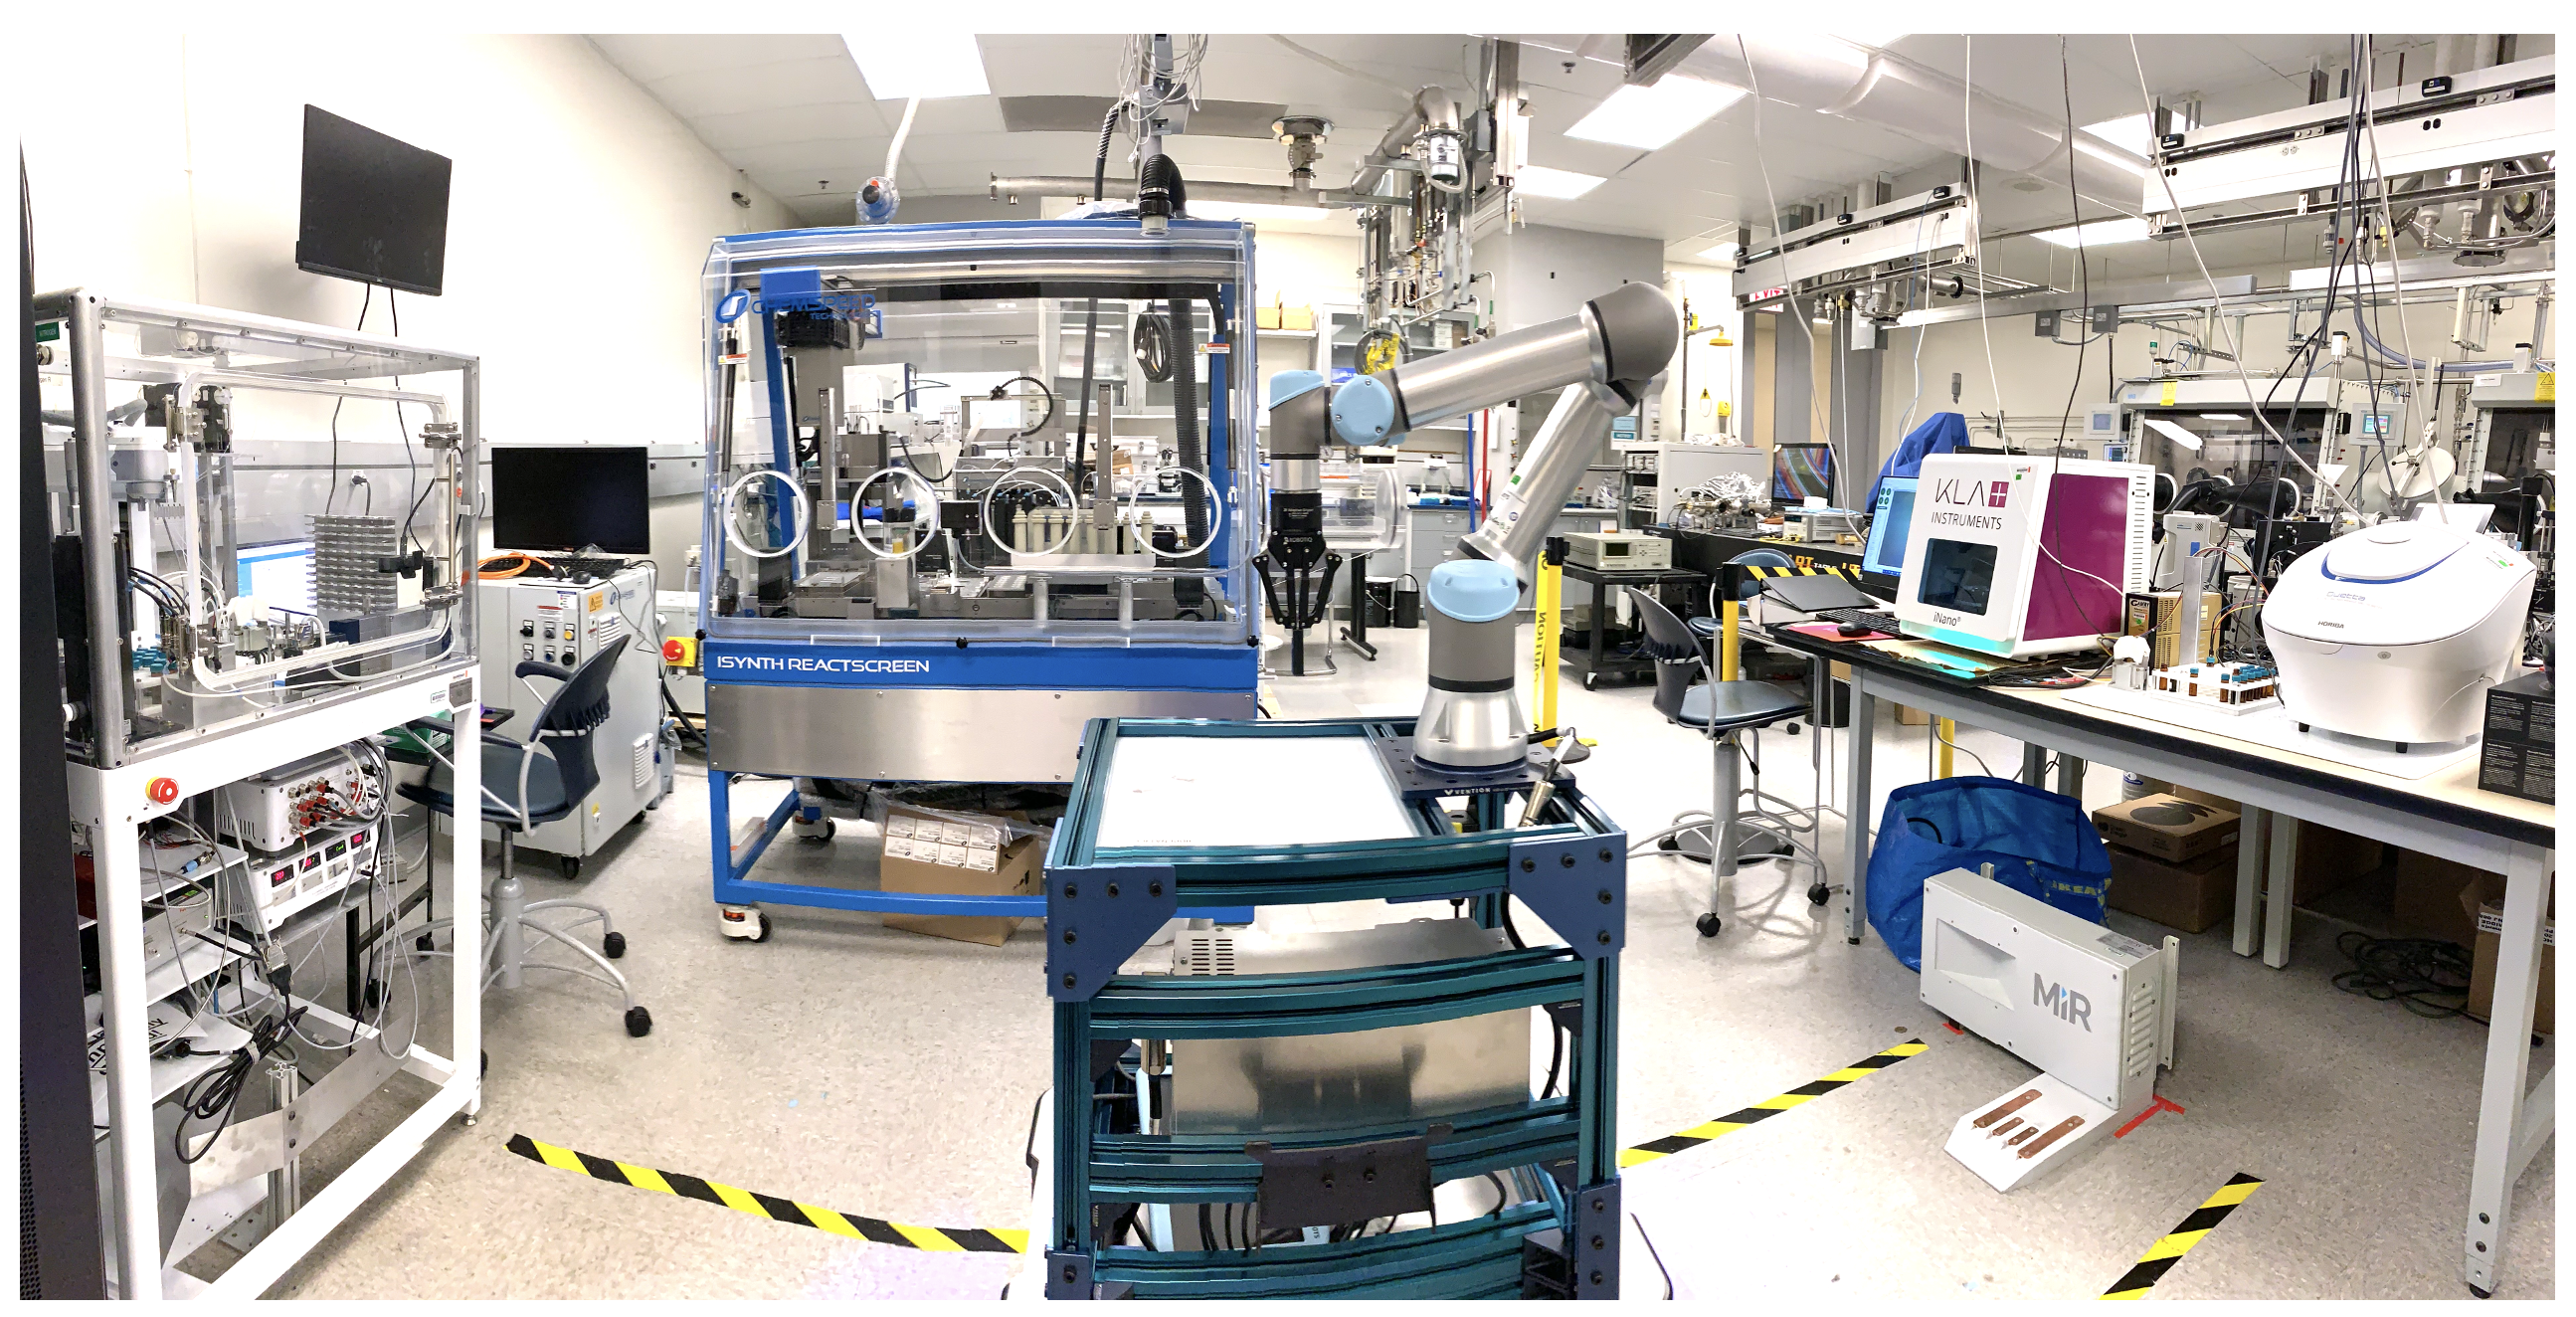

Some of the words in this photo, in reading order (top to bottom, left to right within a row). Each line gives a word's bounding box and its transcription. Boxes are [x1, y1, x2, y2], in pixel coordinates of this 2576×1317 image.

[751, 294, 875, 314] CHEMSPEED
[1931, 511, 2002, 530] INSTRUMENTS
[717, 656, 785, 670] ISYNTH
[788, 658, 930, 673] REACTSCREEN
[1454, 786, 1492, 796] VENTION
[2052, 880, 2097, 896] IKEA
[2033, 972, 2093, 1034] MiR
